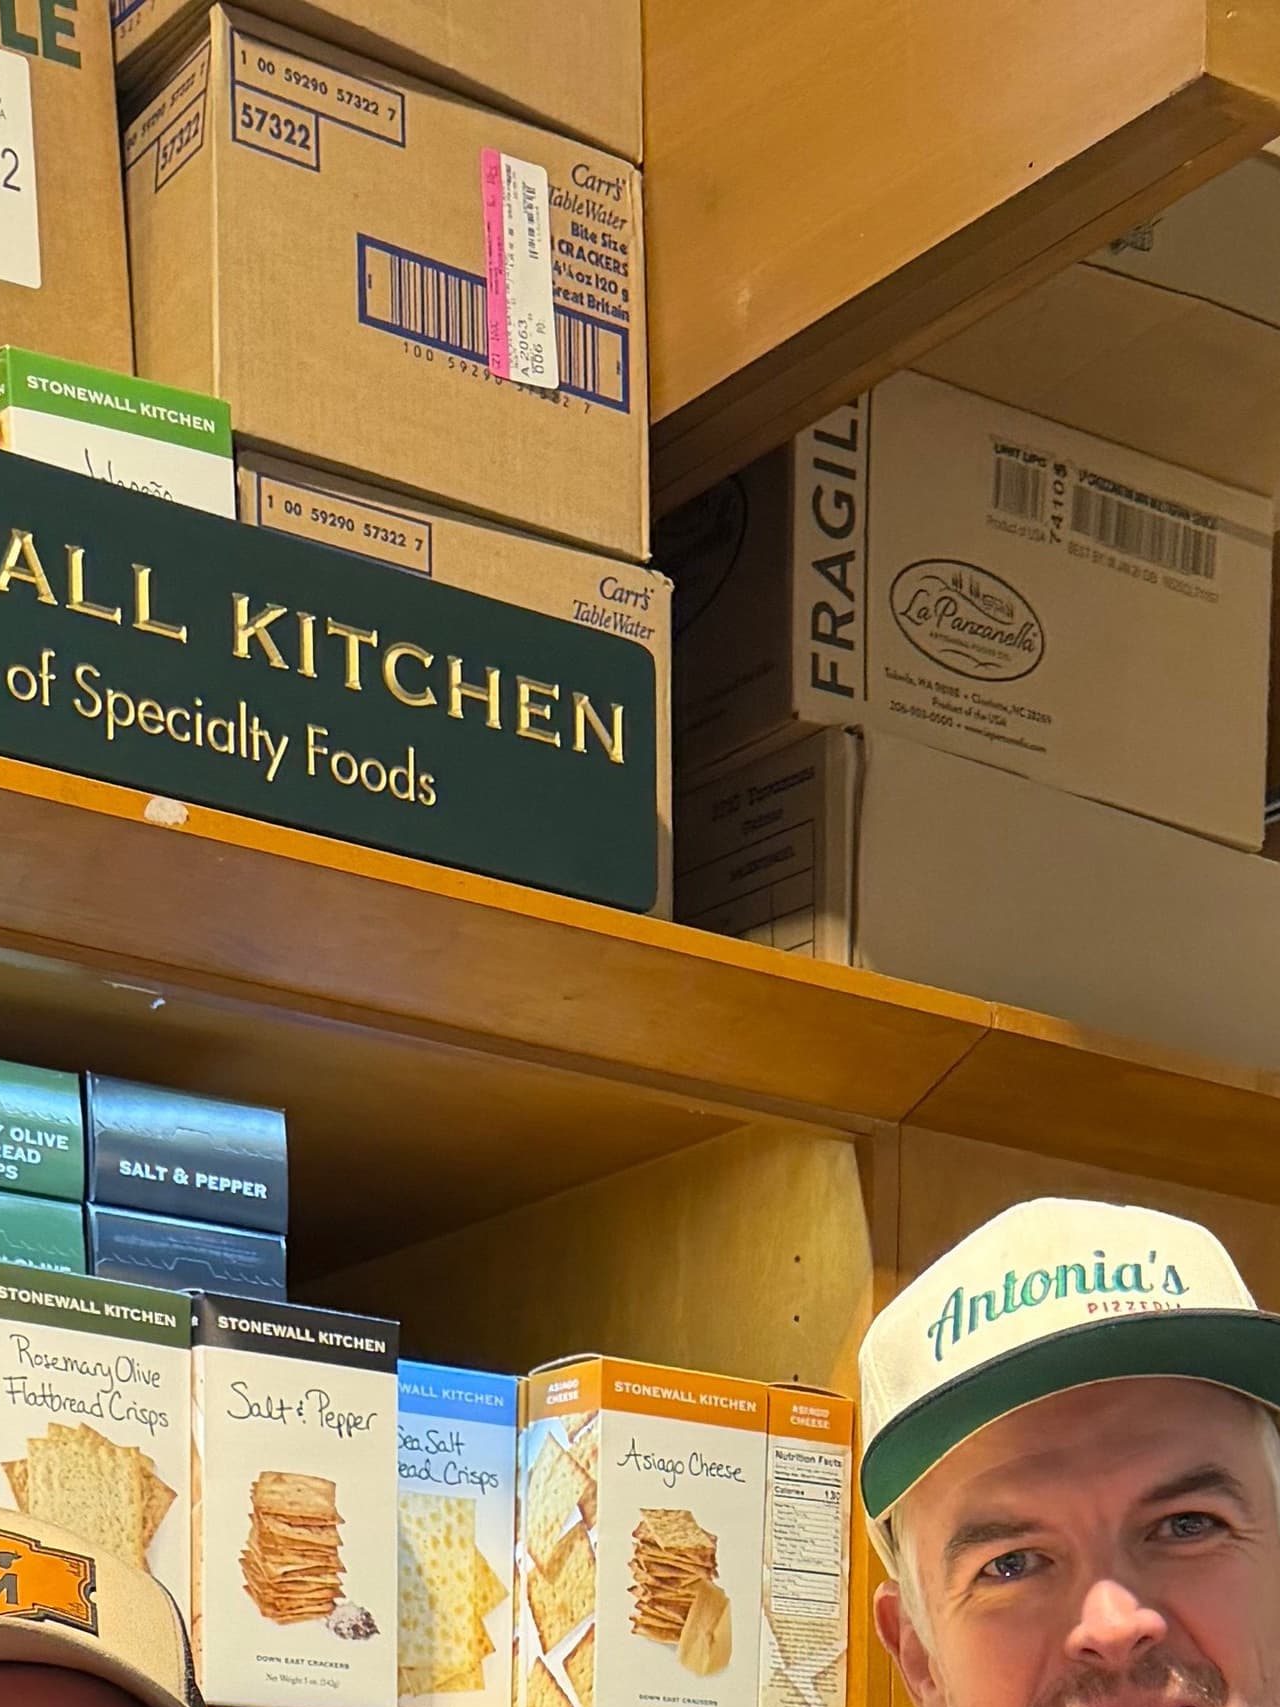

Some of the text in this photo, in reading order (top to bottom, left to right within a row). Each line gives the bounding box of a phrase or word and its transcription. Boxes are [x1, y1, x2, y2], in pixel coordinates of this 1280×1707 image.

[240, 50, 397, 121] 1 00 59290 57322 7
[240, 104, 312, 151] 57322
[25, 373, 217, 434] STONEWALL KITCHEN
[934, 595, 1038, 655] Panzanella
[231, 590, 626, 767] KITCHEN
[6, 648, 56, 708] of
[75, 664, 289, 783] Specialty
[306, 723, 438, 808] Foods
[10, 1126, 70, 1151] OLIVE
[119, 1159, 268, 1200] SALT & PEPPER
[217, 1315, 386, 1353] STONEWALL KITCHEN
[928, 1249, 1190, 1362] Antonia's
[226, 1381, 294, 1424] Salt
[306, 1389, 378, 1438] Pepper
[614, 1381, 757, 1413] STONEWALL KITCHEN
[617, 1439, 746, 1488] Asiago Cheese
